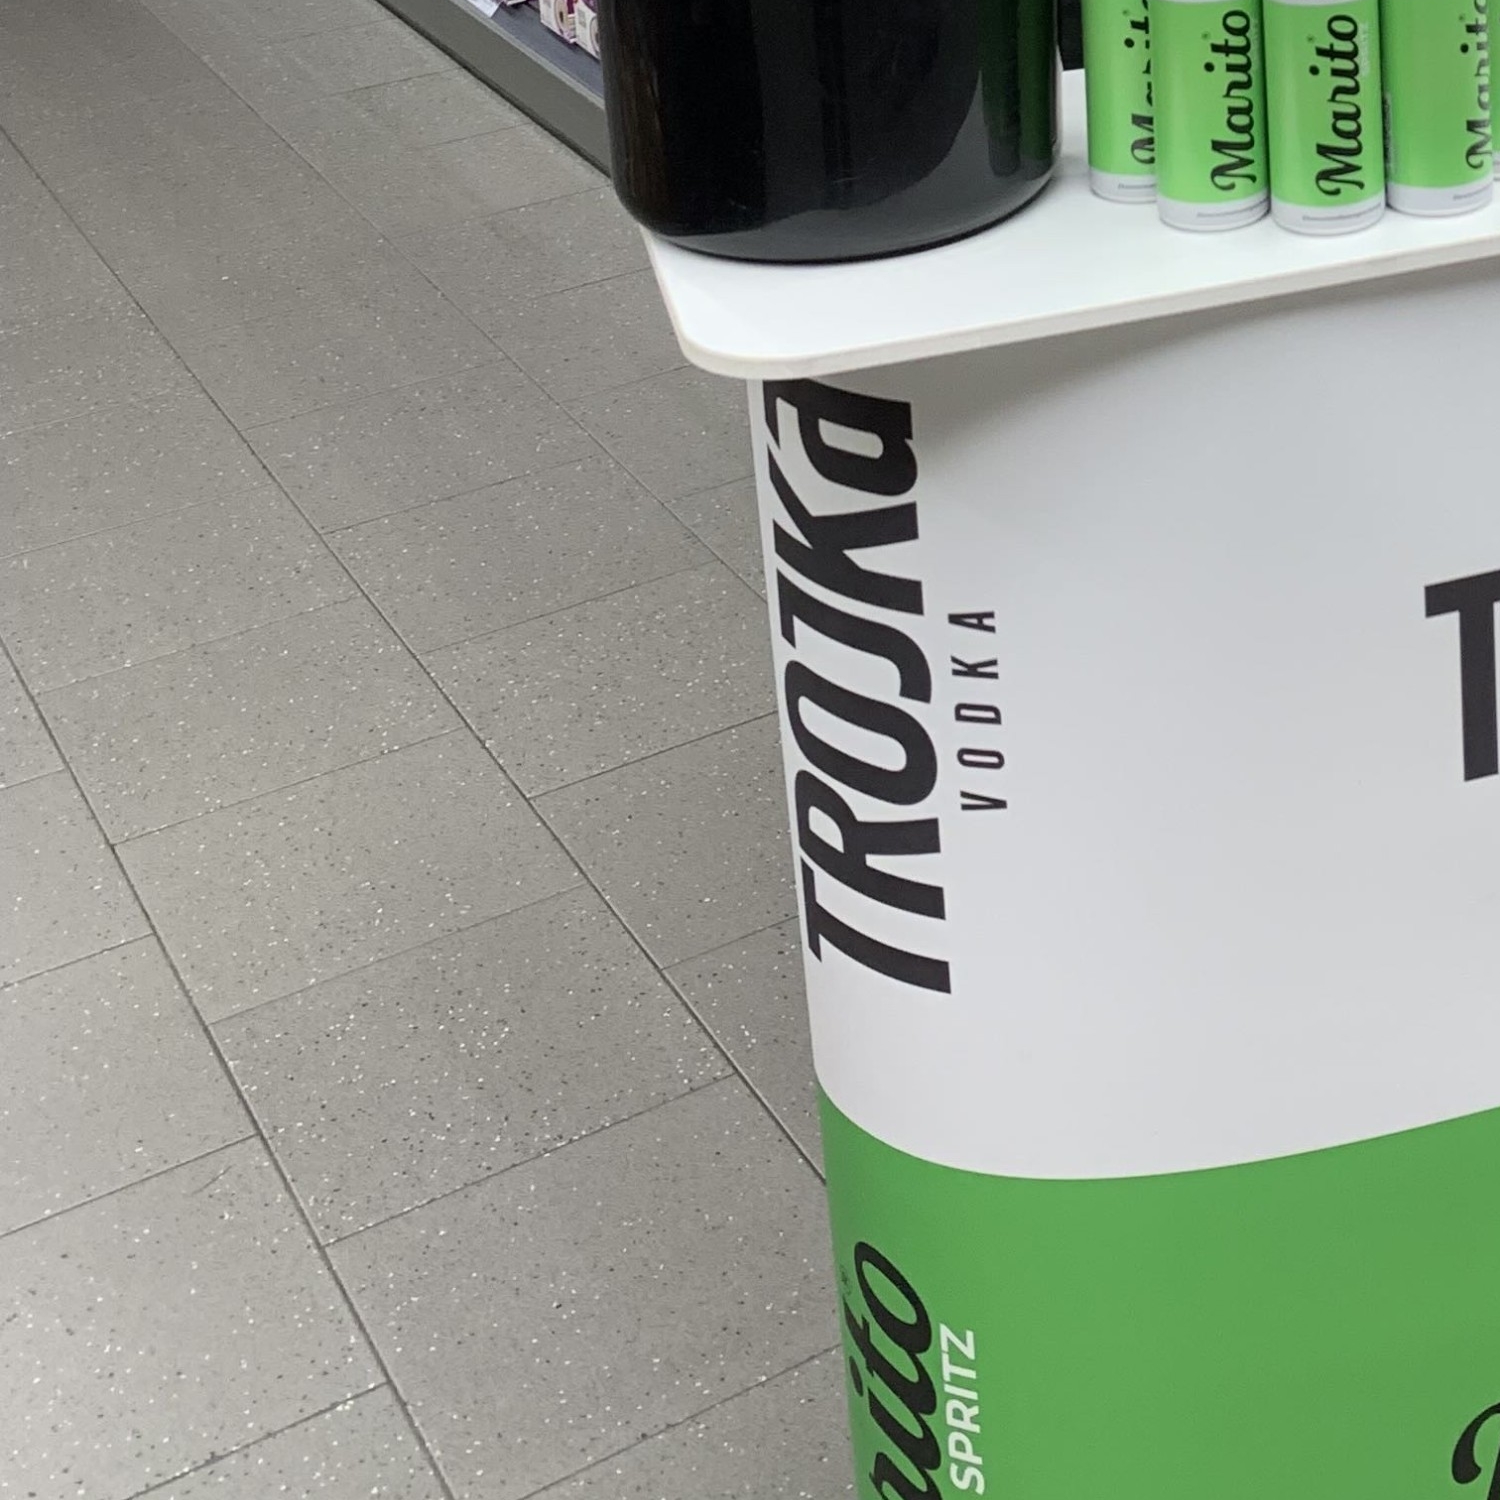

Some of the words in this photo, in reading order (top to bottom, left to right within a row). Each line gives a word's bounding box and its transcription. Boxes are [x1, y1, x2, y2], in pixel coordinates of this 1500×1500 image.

[1204, 8, 1258, 193] Marito
[1308, 12, 1366, 197] Marito
[946, 609, 1008, 813] VODKA
[943, 1326, 985, 1496] SPRITZ
